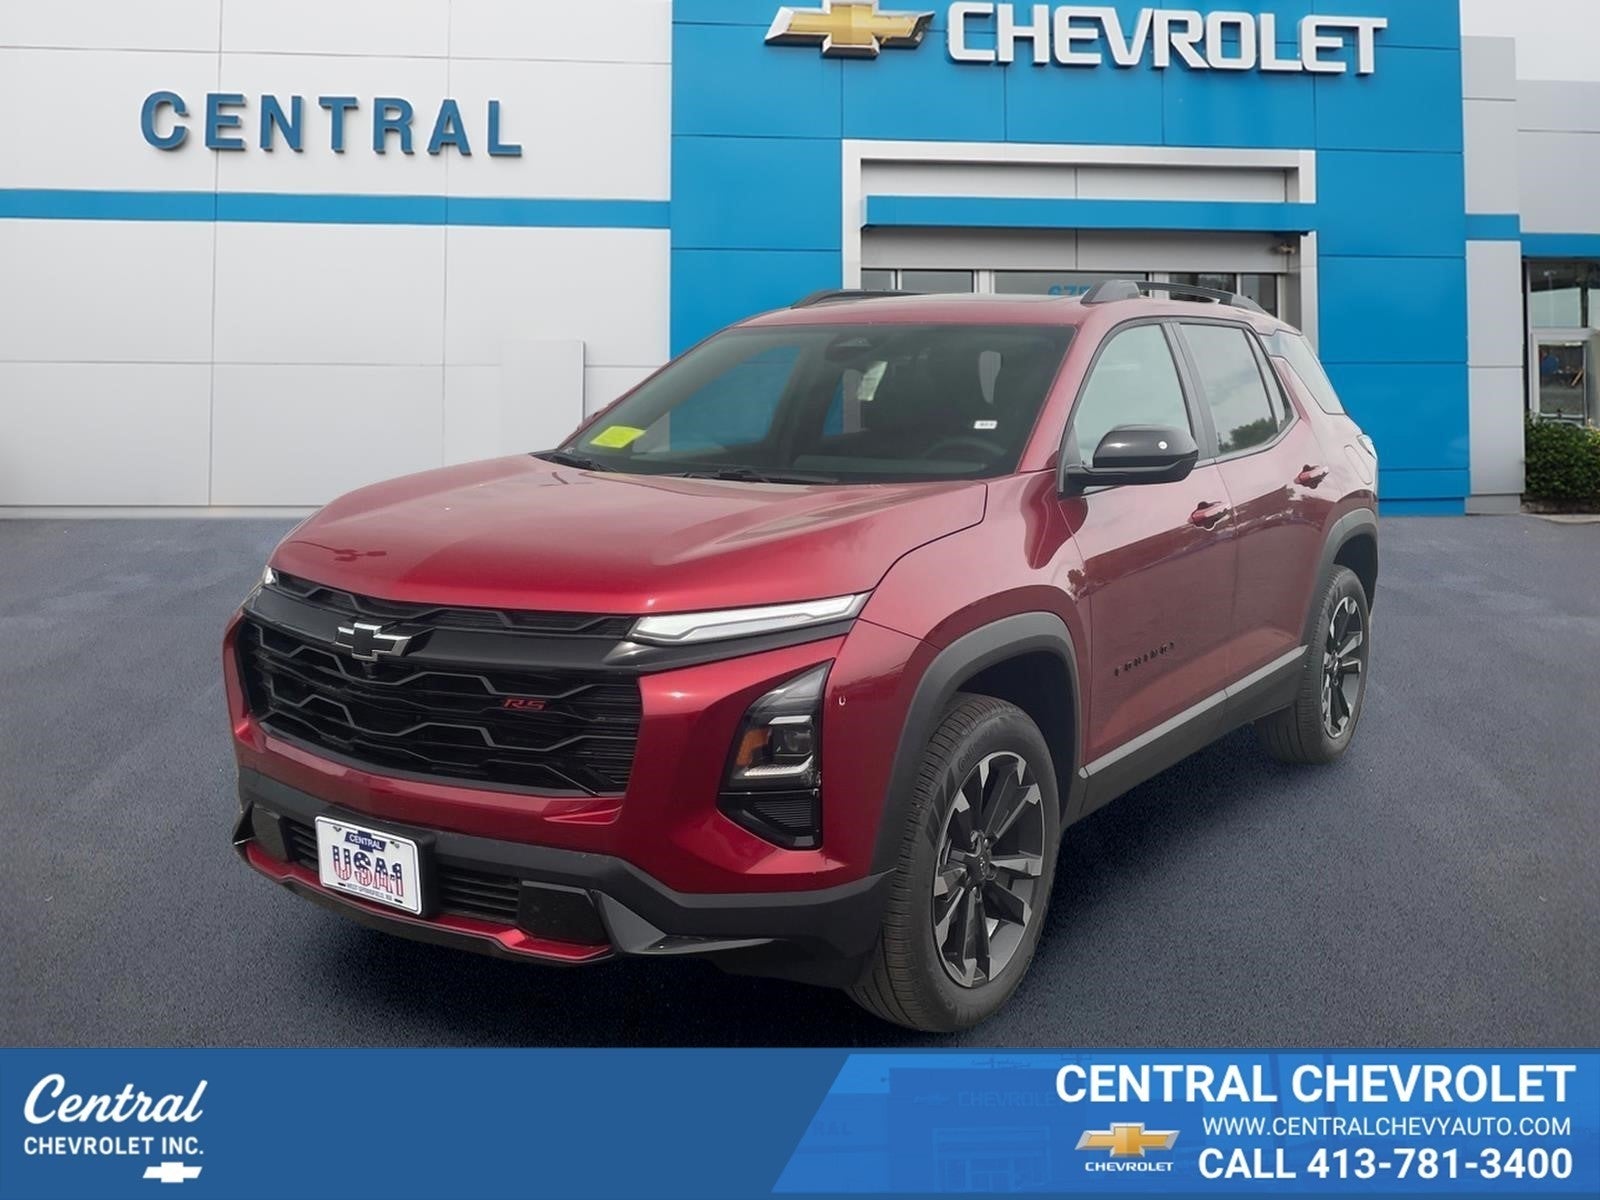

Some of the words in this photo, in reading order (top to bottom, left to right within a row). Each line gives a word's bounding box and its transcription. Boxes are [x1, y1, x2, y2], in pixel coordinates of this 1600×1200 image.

[947, 1, 1388, 75] CHEVROLET
[140, 91, 522, 157] CENTRAL
[504, 697, 546, 711] RS
[348, 833, 383, 850] CENTRAL
